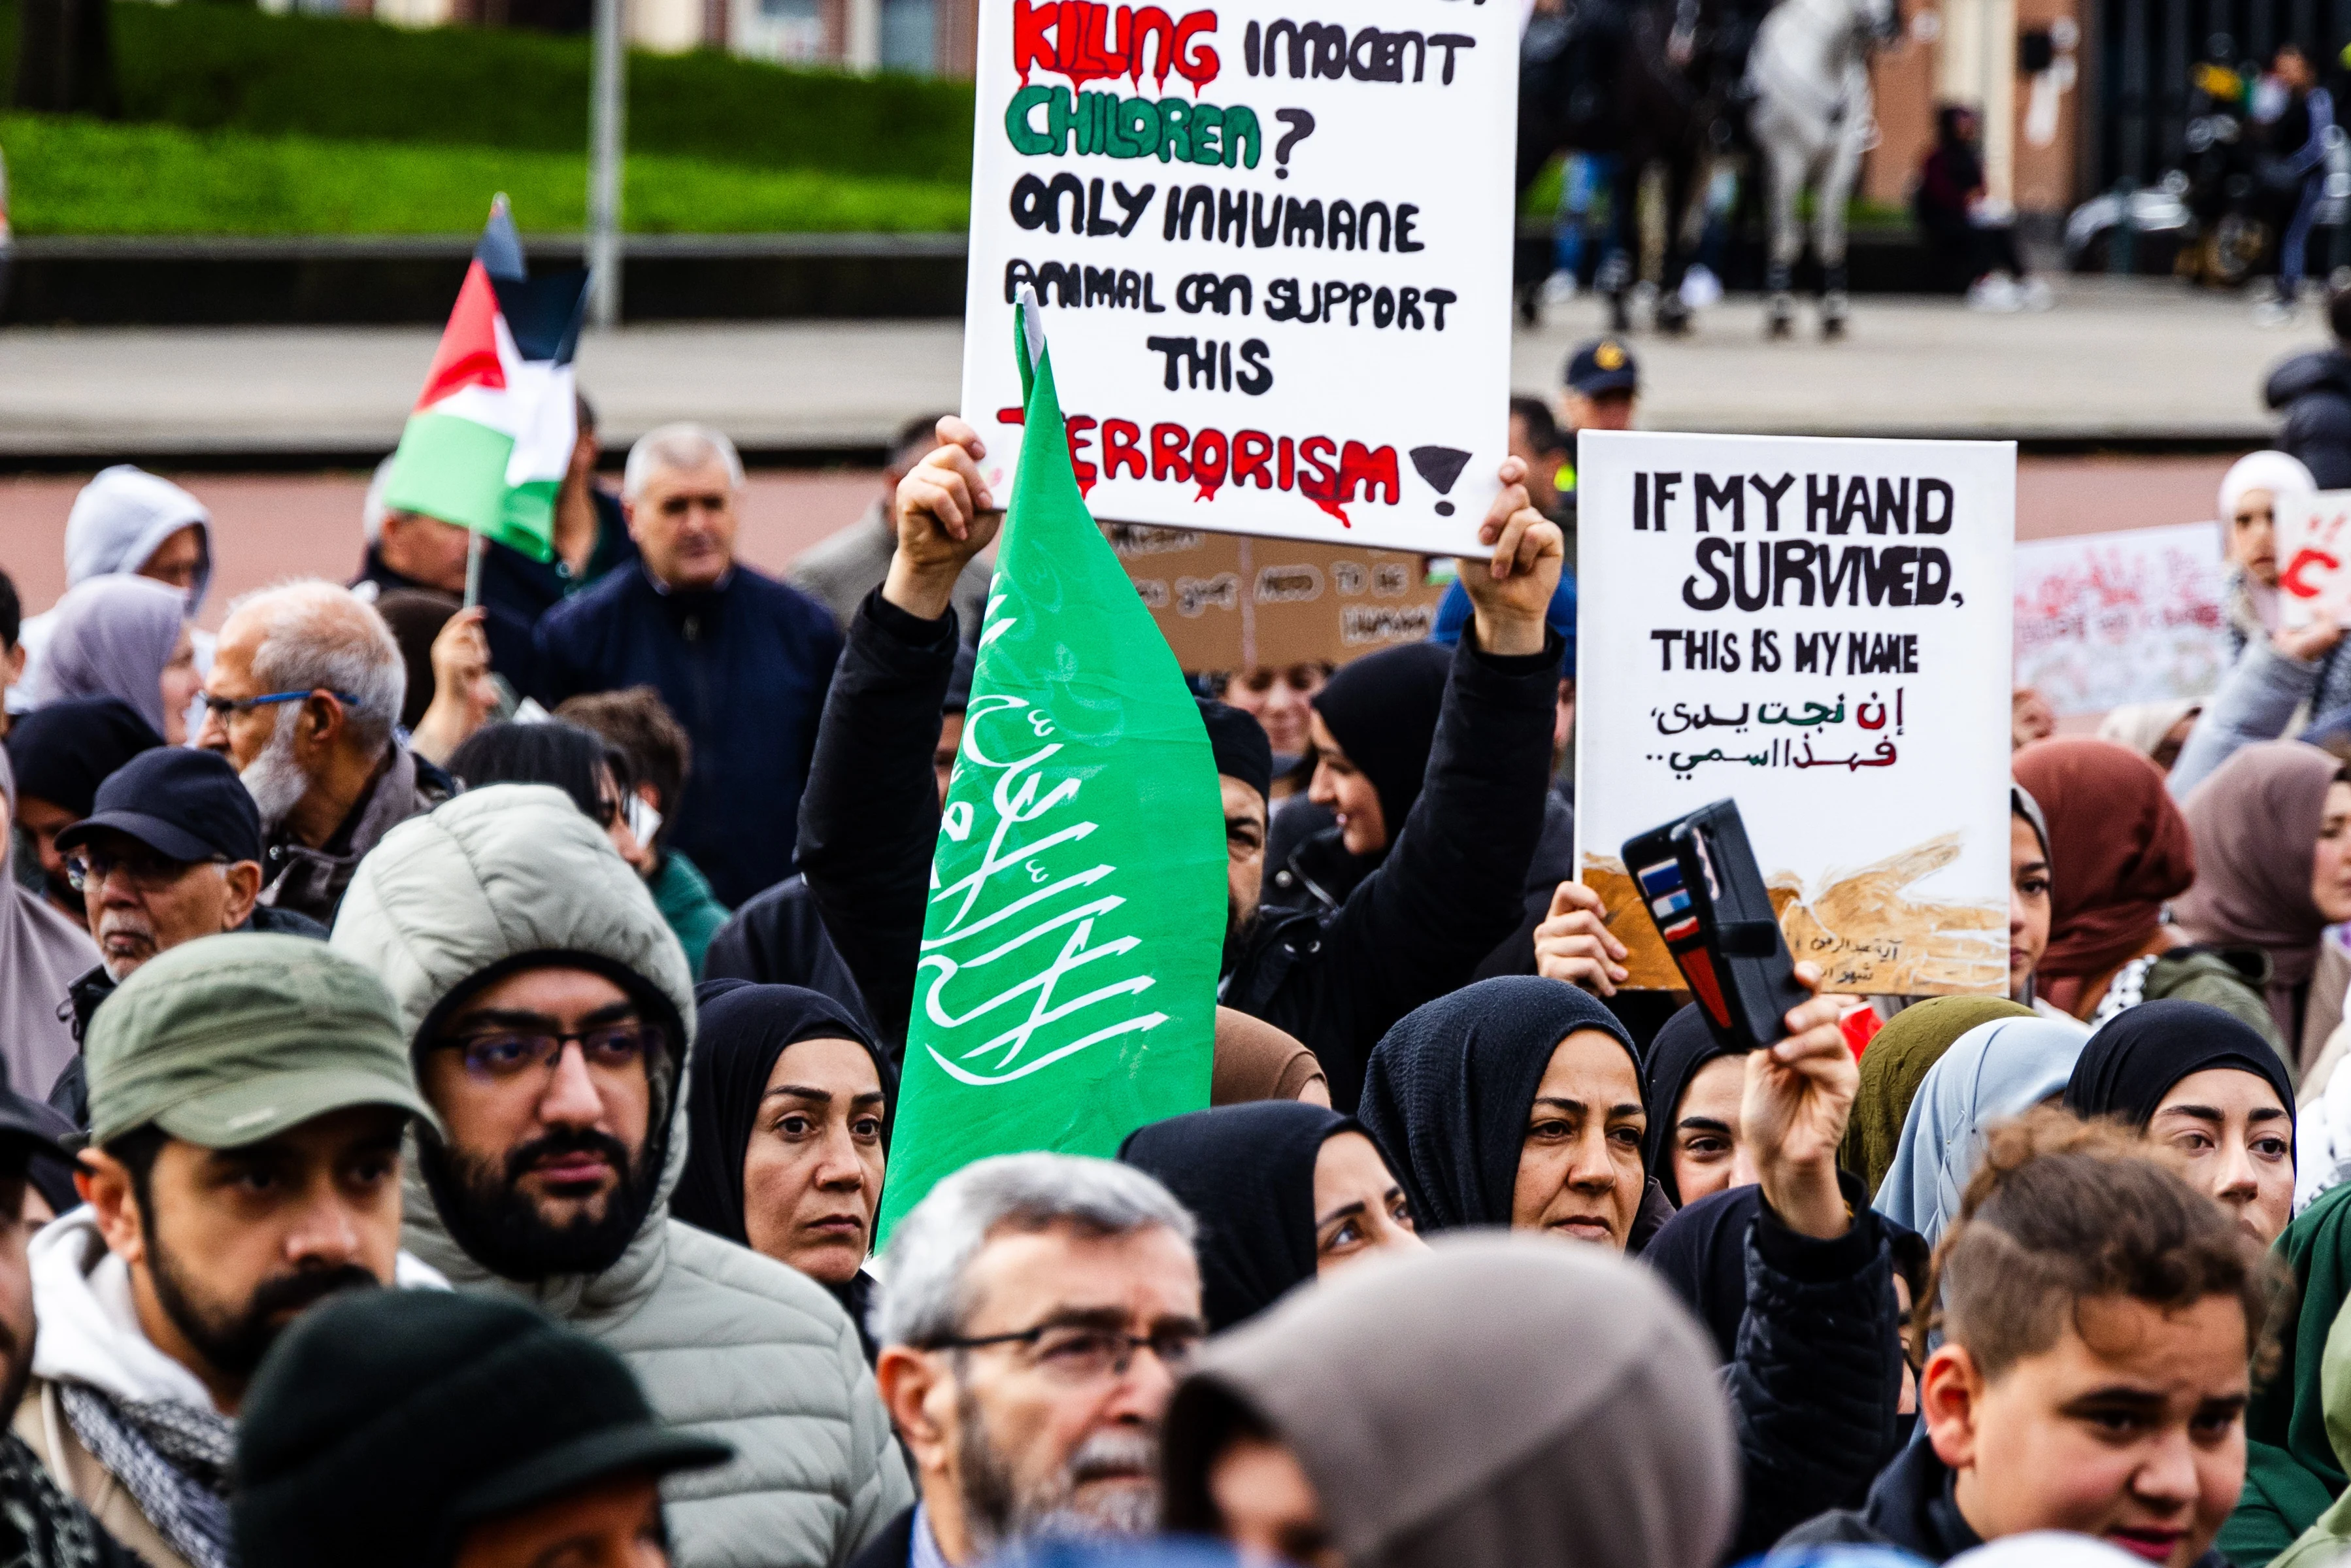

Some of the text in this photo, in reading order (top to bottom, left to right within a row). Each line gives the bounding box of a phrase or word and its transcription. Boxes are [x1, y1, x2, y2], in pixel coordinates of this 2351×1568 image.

[1014, 0, 1476, 98] KILLING INNOCENT
[1009, 172, 1425, 254] ONLY INHUMANE
[1004, 258, 1458, 332] ANIMAL CAN SUPPORT
[1146, 335, 1274, 396] THIS
[1633, 472, 1954, 535] IF MY HAND
[1682, 537, 1964, 612] SURVIVED,
[1650, 628, 1918, 676] THIS IS MY NAME
[1758, 693, 1845, 734] نجت
[1856, 687, 1903, 736] إن
